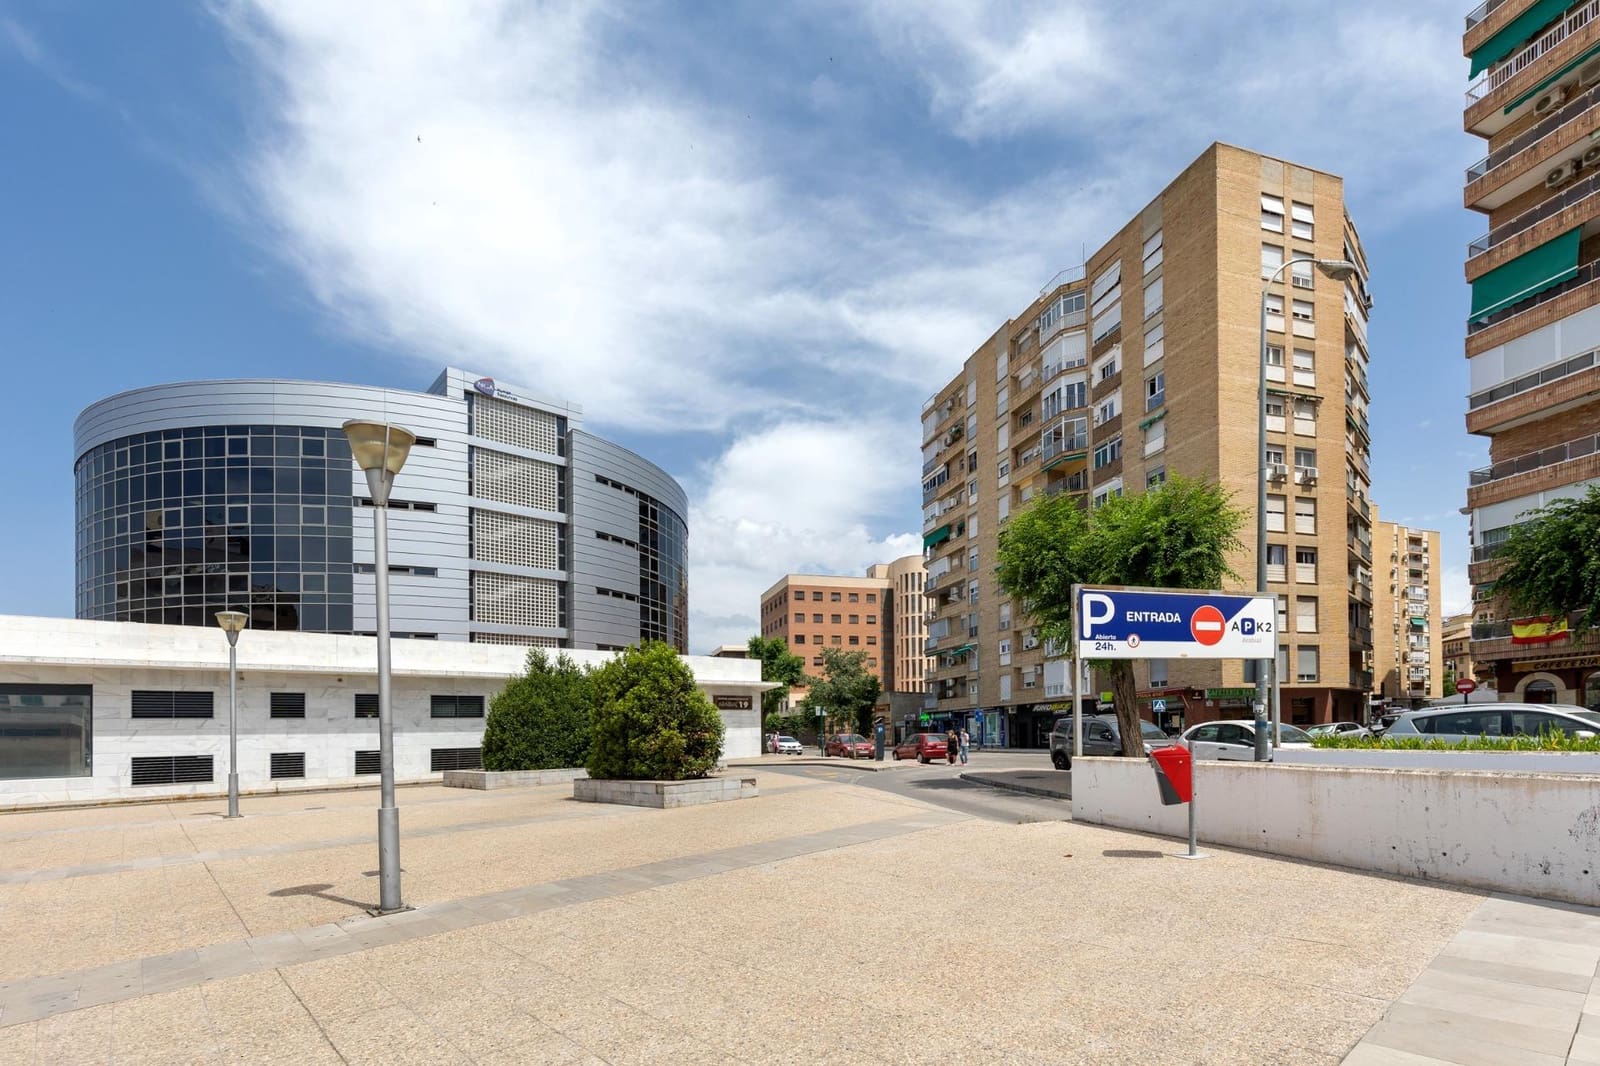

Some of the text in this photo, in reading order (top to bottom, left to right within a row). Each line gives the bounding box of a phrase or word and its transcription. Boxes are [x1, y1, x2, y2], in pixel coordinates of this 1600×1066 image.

[1082, 593, 1115, 638] P
[1126, 611, 1181, 623] ENTRADA
[1095, 642, 1116, 651] 24h.
[1534, 657, 1598, 669] CAFETERIA
